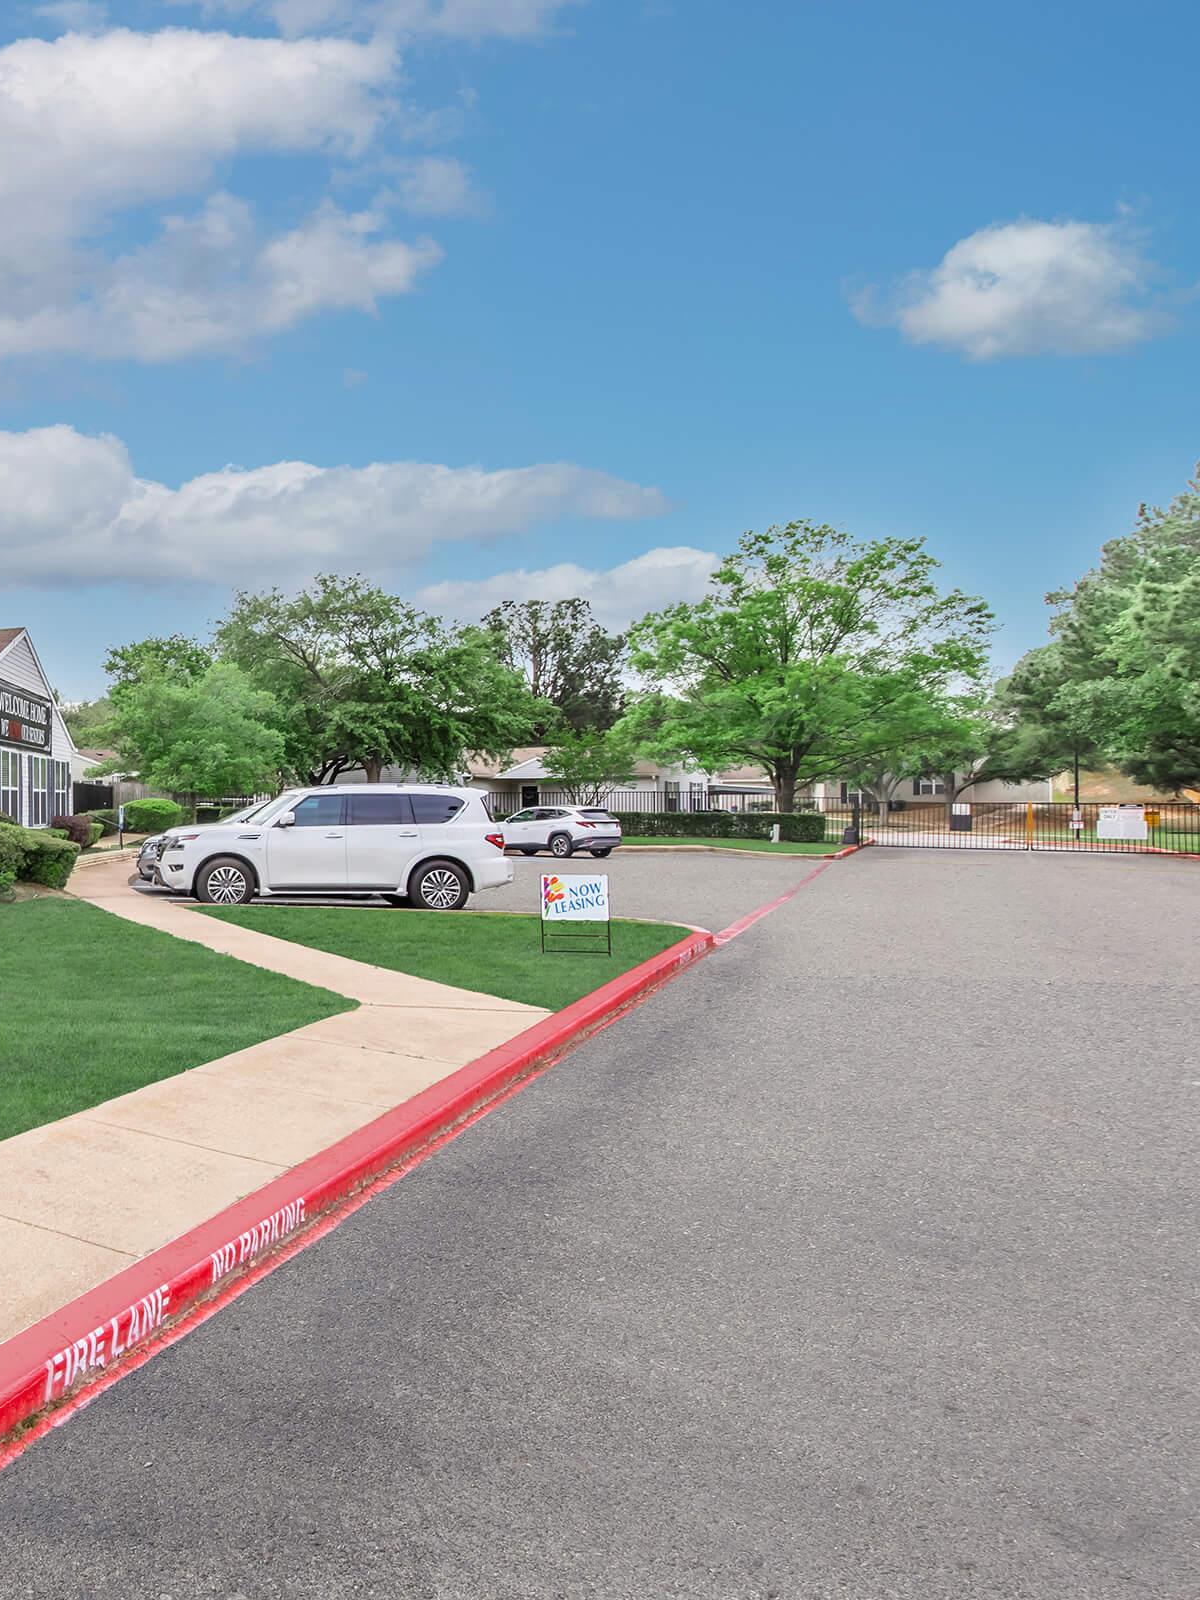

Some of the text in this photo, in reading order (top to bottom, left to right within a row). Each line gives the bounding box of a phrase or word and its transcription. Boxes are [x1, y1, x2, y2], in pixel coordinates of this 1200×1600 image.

[30, 702, 48, 725] HOME
[568, 882, 602, 898] NOW
[554, 894, 605, 914] LEASING
[44, 1197, 305, 1403] FIRE LANE NO PARKING
